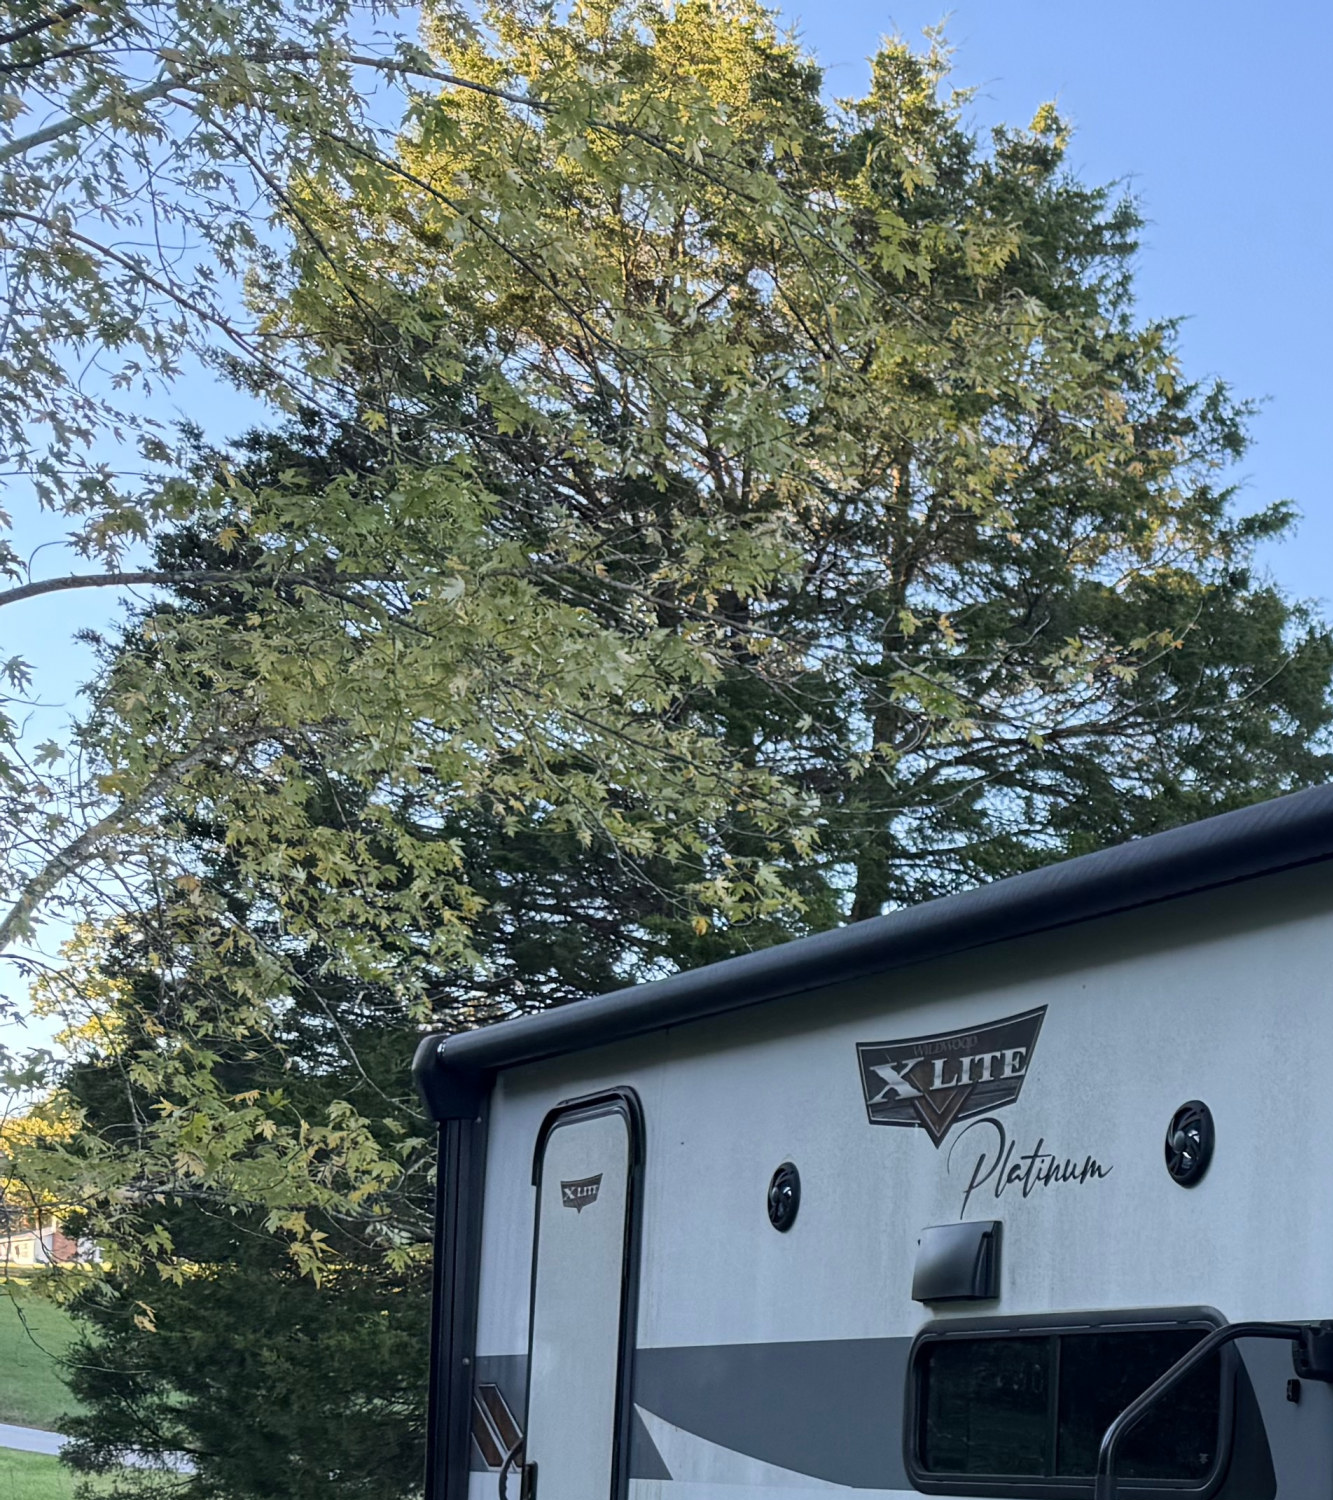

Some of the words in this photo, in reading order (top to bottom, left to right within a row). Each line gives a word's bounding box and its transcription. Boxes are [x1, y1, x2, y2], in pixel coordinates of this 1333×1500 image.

[867, 1058, 925, 1104] X
[929, 1047, 1027, 1090] LITE
[947, 1117, 1113, 1220] Platinum
